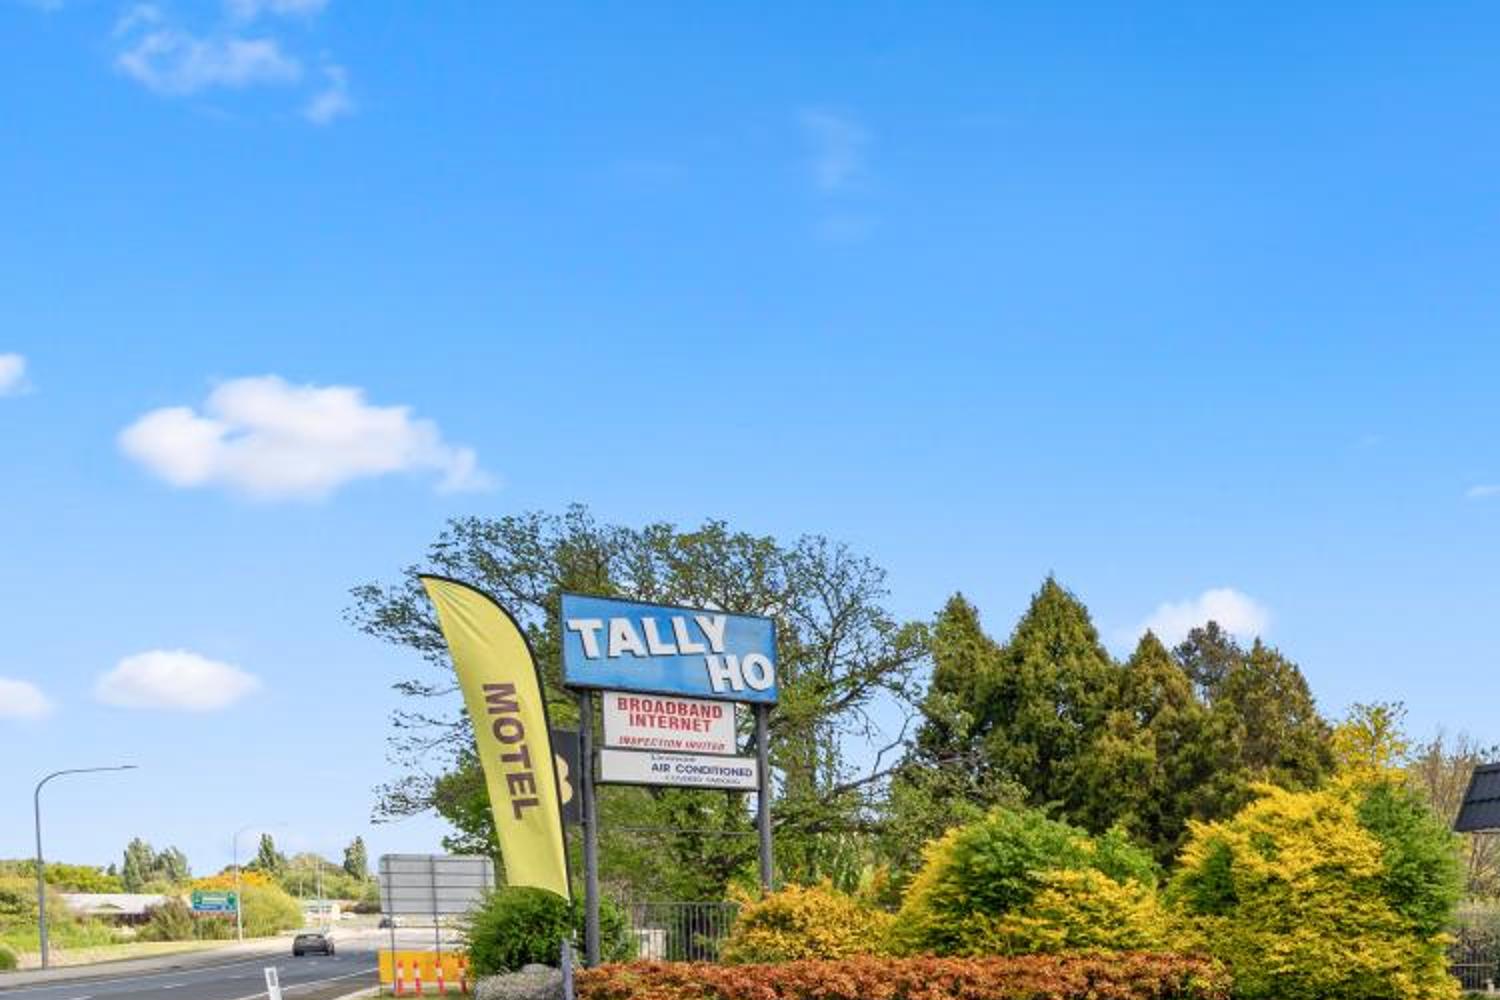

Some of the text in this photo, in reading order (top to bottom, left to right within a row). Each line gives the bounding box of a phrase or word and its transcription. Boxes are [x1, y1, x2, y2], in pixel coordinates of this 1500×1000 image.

[566, 614, 726, 659] TALLY
[705, 653, 775, 693] HO
[617, 697, 723, 718] BROADBAND
[629, 714, 713, 732] INTERNET
[482, 683, 539, 820] MOTEL
[618, 735, 726, 751] INSPECTION INVITED
[651, 764, 753, 776] AIR CONDITIONED
